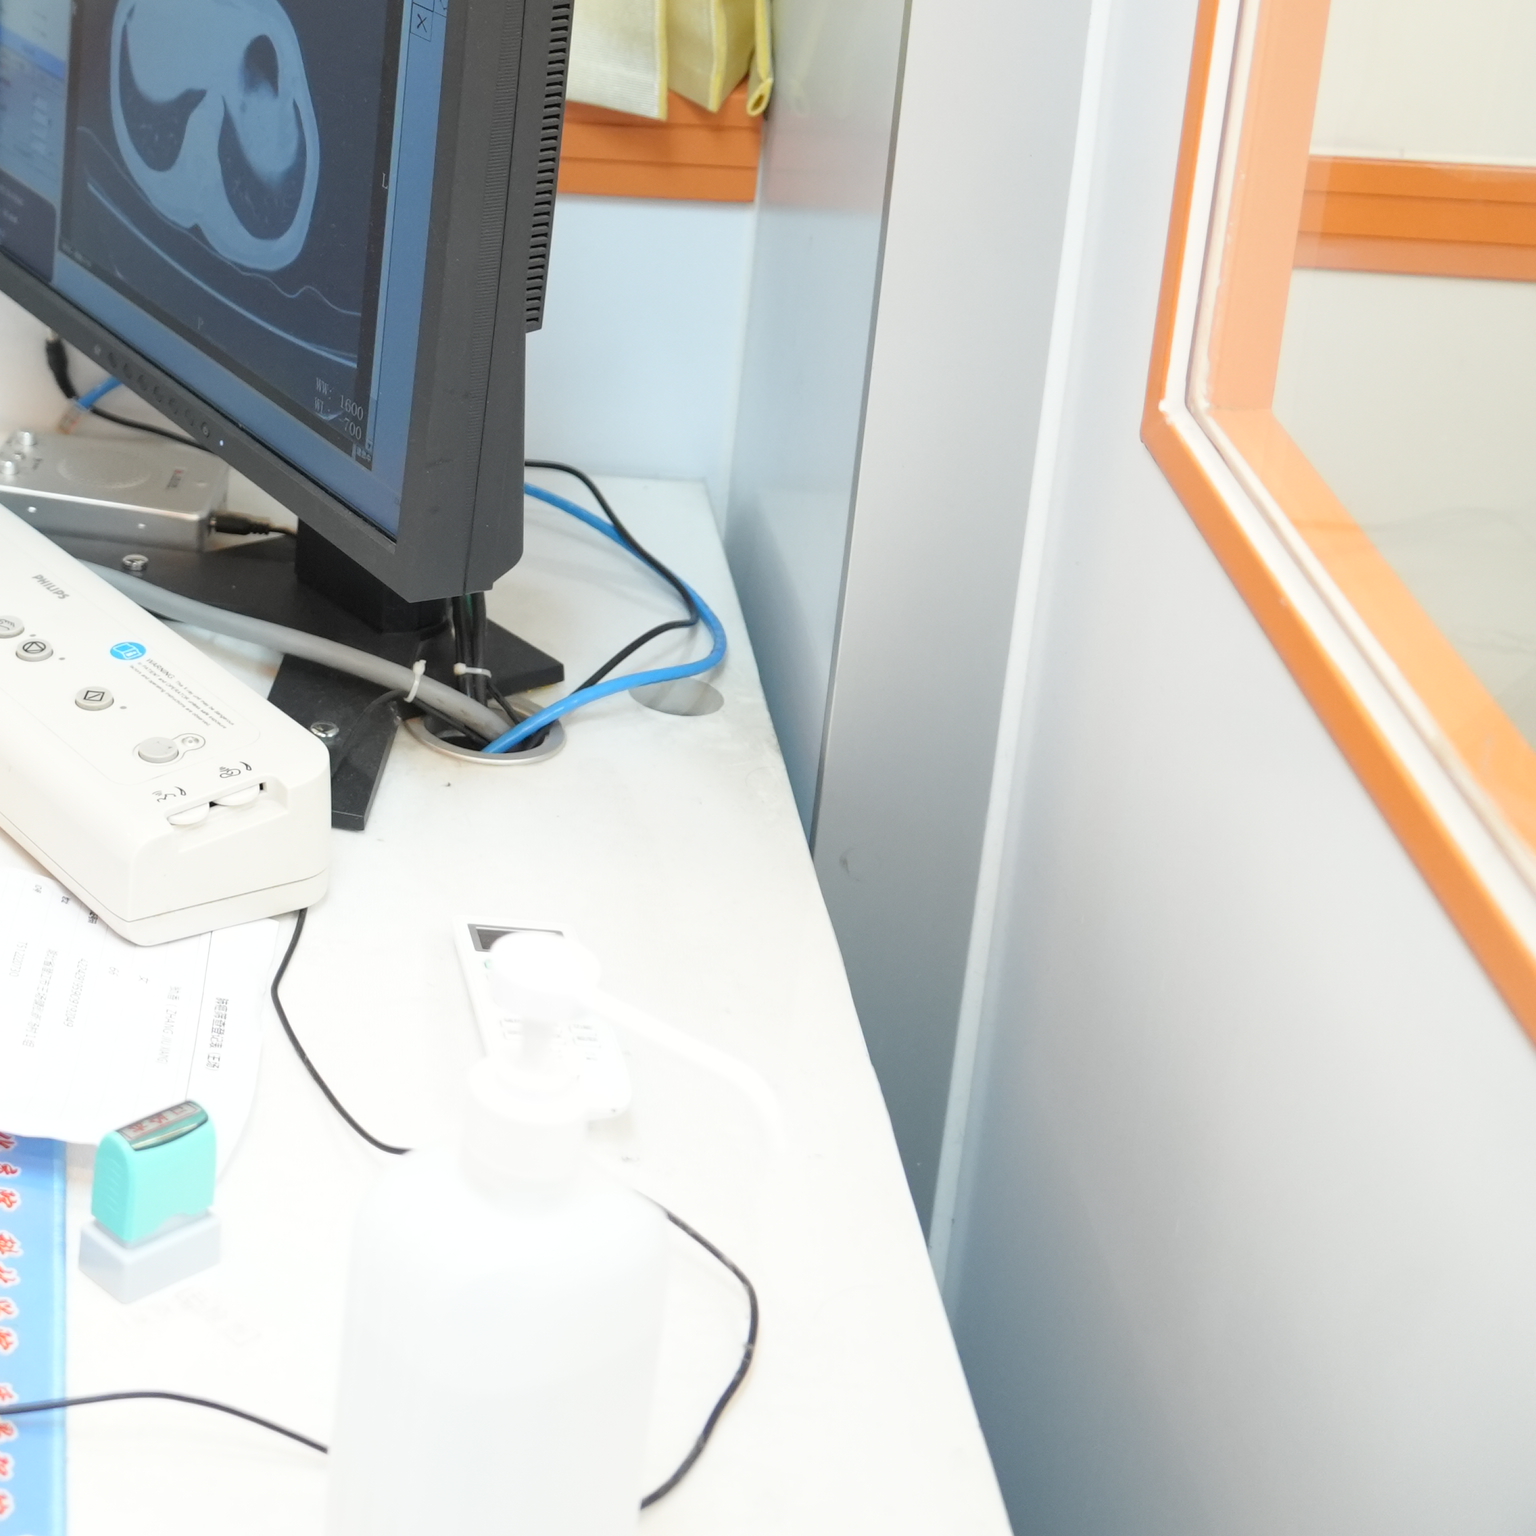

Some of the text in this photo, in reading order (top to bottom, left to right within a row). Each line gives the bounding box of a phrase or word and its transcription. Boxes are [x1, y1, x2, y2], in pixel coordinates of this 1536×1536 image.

[338, 392, 365, 420] 1600
[337, 414, 364, 441] -700
[31, 573, 71, 602] PHILIPS
[108, 966, 120, 976] 66
